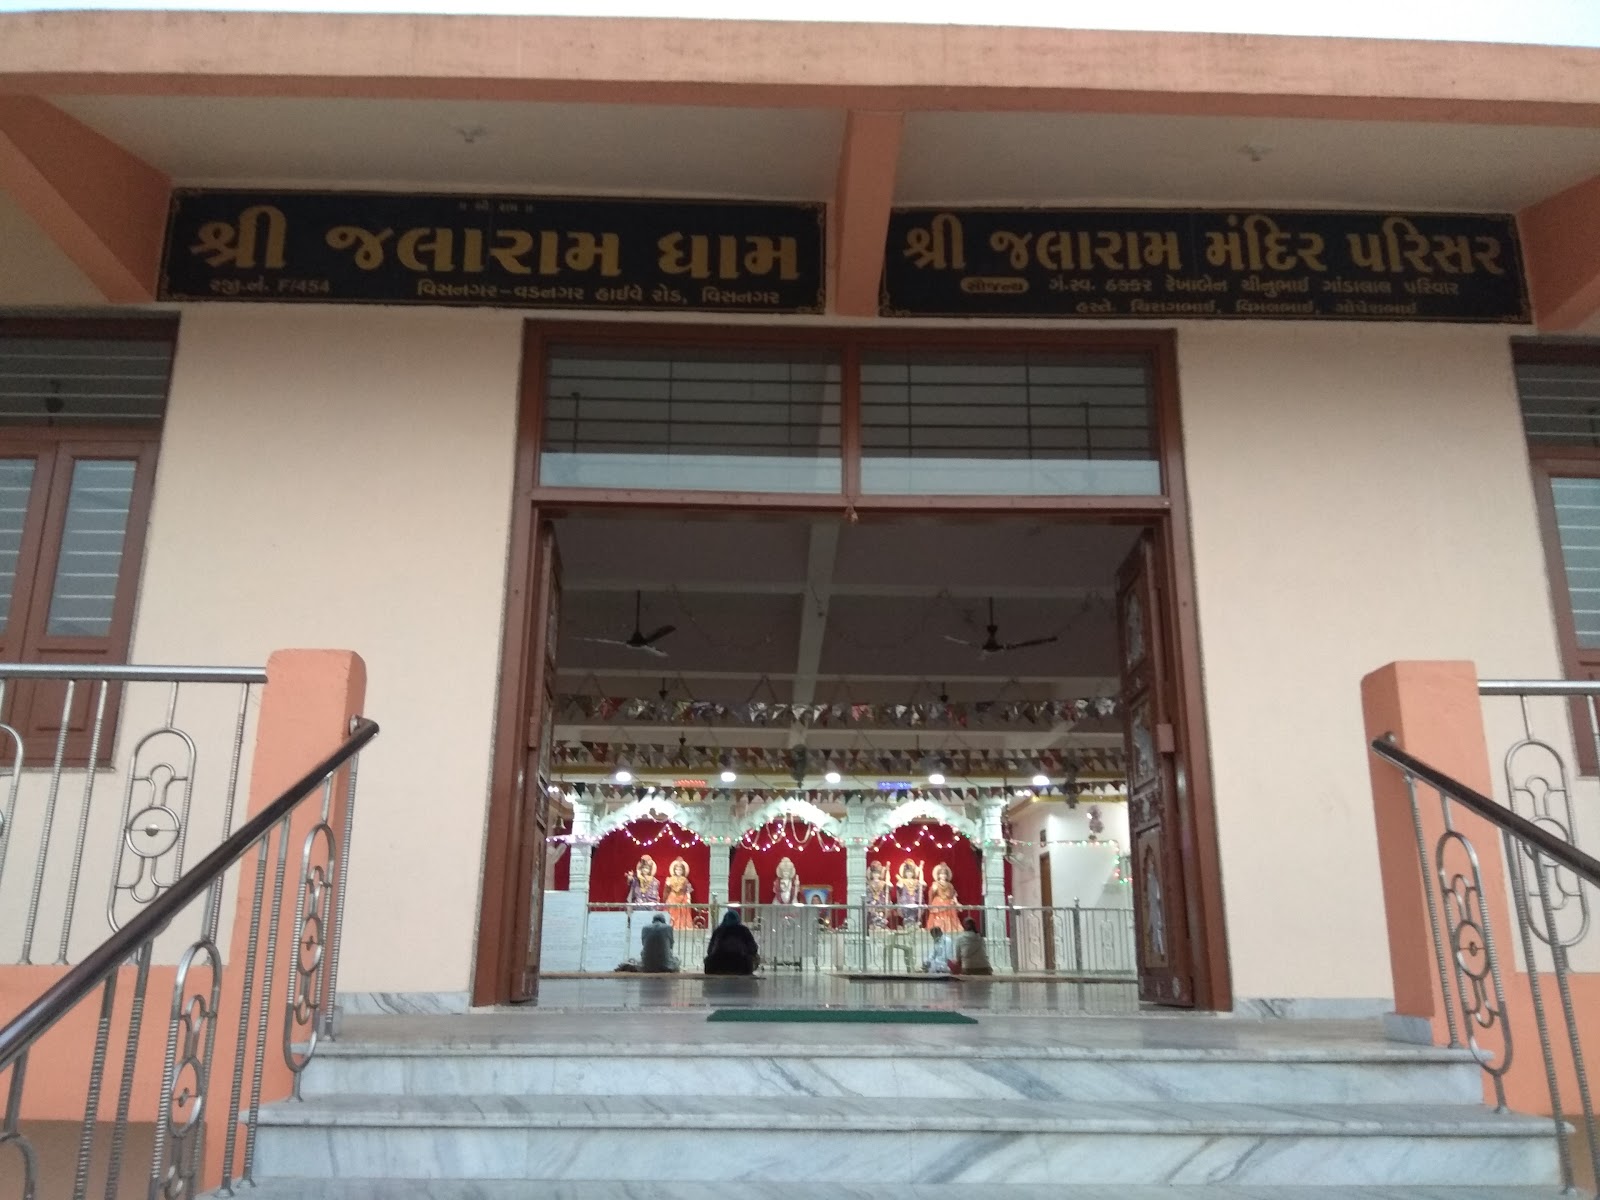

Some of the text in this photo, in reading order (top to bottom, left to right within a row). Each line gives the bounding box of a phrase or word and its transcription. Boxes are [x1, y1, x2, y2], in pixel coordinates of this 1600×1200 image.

[189, 204, 800, 281] શ્રી જલારામ ધામ
[903, 213, 1506, 275] શ્રી જલારામ મંદિર પરિસર
[702, 285, 781, 304] વિસનગર
[1403, 276, 1459, 296] પરિવાર
